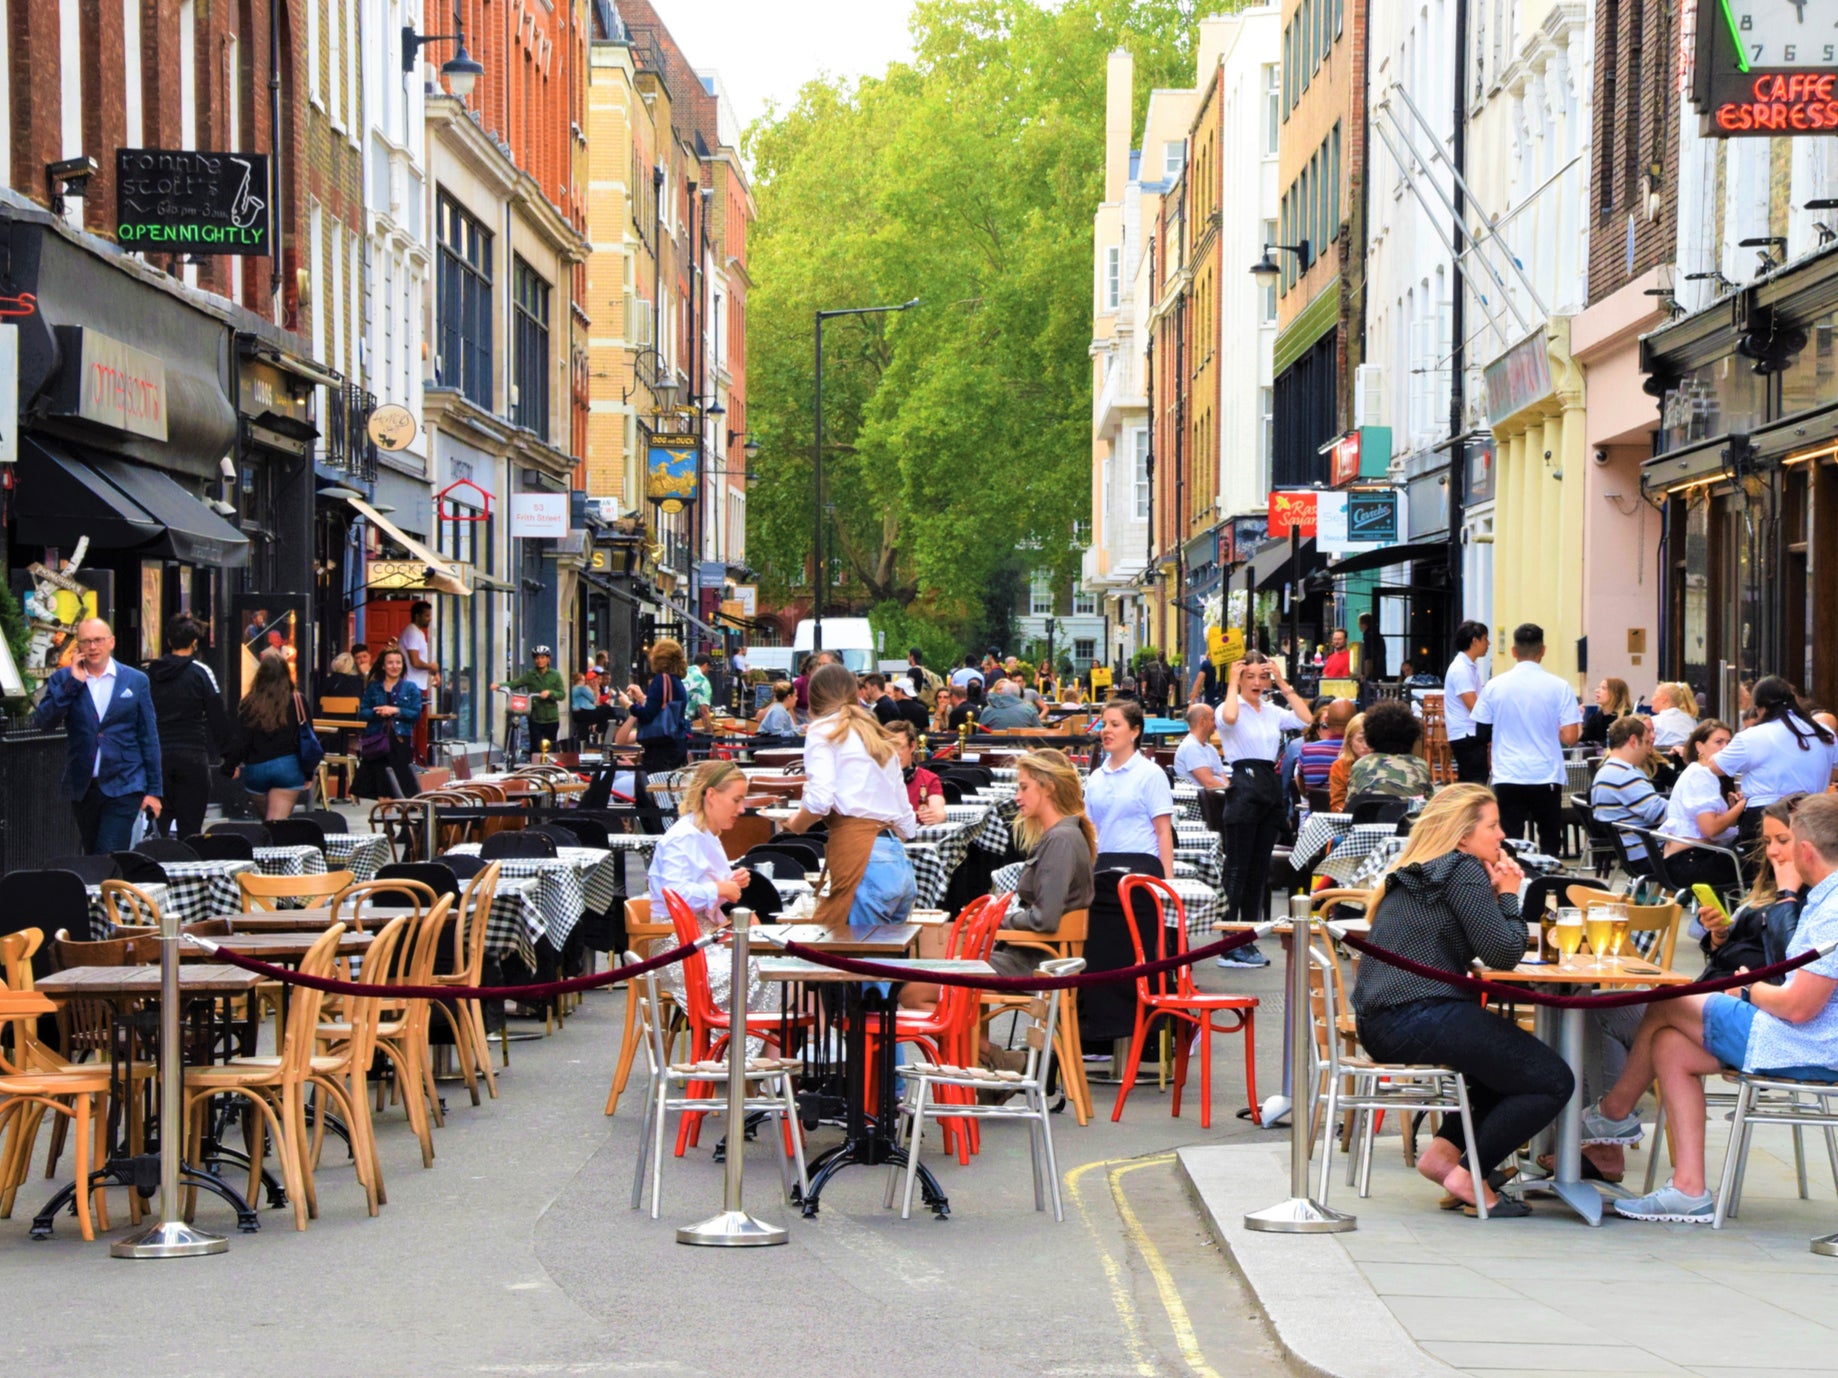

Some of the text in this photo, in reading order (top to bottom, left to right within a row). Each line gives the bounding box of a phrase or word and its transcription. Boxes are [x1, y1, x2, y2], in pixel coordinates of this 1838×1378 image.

[1740, 15, 1752, 30] 8
[1751, 45, 1834, 61] 7 6 5
[1753, 75, 1836, 102] CAFFE
[651, 436, 667, 445] DOG
[676, 437, 695, 446] DUCK
[516, 513, 561, 522] Frith Street
